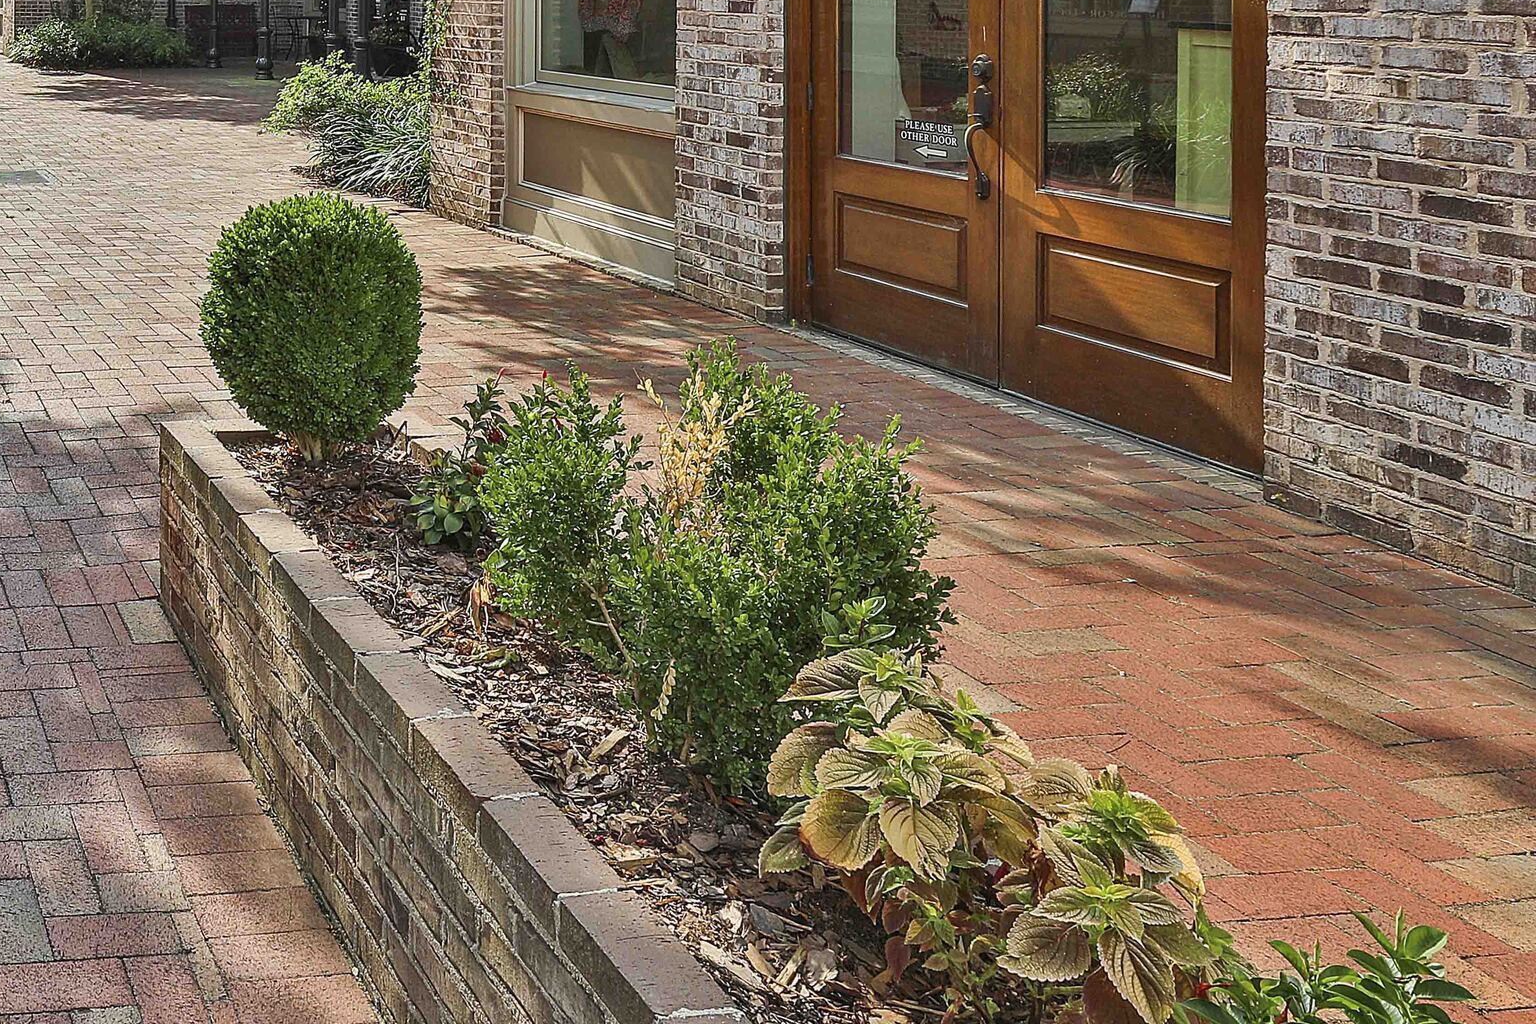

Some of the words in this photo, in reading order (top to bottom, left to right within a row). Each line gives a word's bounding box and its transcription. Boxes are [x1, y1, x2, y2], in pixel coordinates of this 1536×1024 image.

[905, 120, 935, 131] PLEASE
[937, 124, 953, 134] USE
[900, 130, 930, 143] OTHER
[932, 136, 957, 147] DOOR
